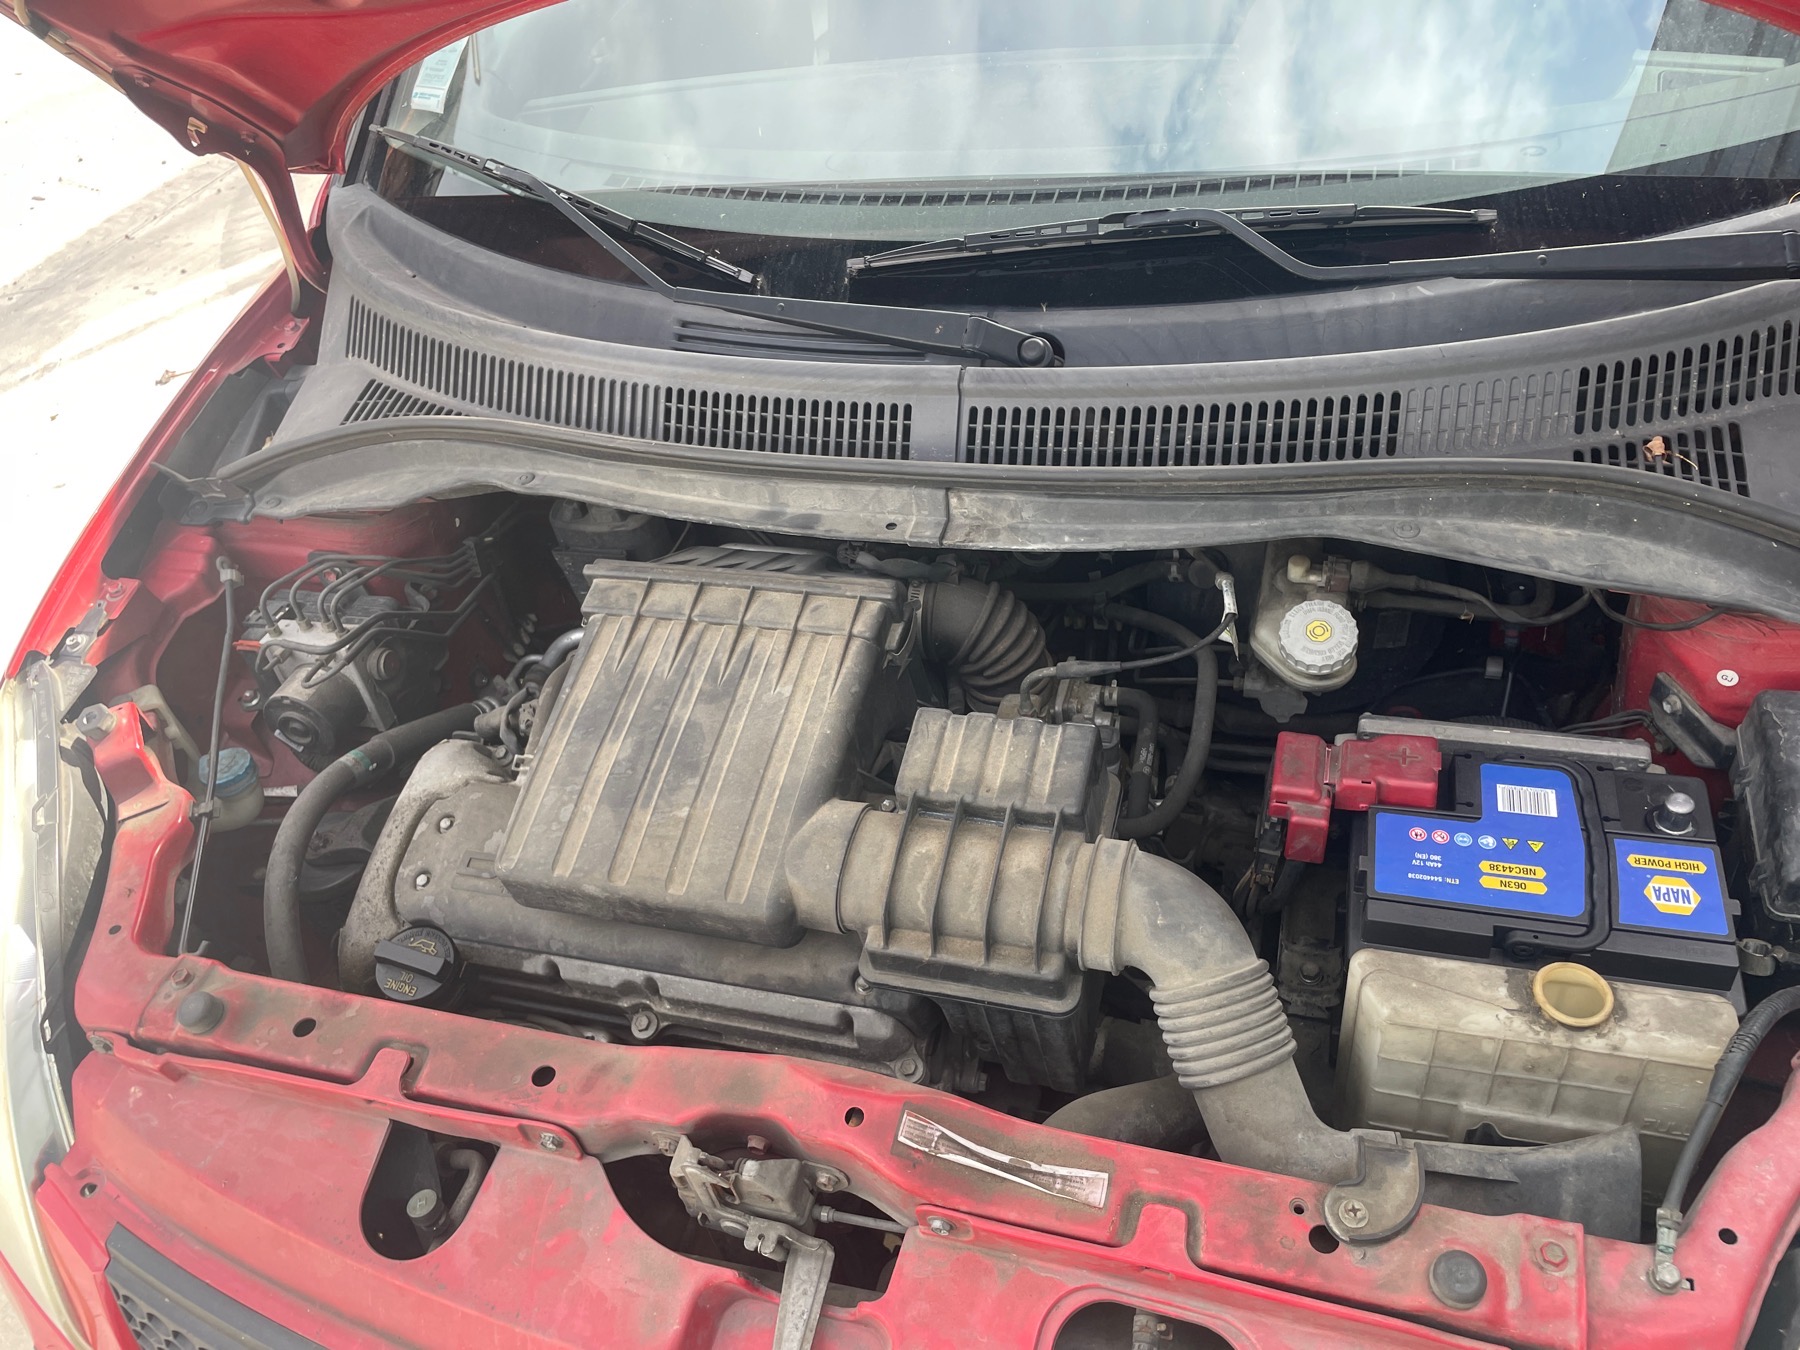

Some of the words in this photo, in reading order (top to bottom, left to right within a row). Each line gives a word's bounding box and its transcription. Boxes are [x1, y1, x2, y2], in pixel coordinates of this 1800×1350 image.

[1721, 674, 1734, 682] GJ
[1634, 857, 1671, 868] POWER
[1674, 861, 1699, 871] HIGH
[1489, 864, 1536, 876] NBC4438
[1444, 877, 1460, 885] ETN:
[1500, 880, 1527, 890] 063N
[1652, 885, 1692, 905] NAPA
[401, 971, 414, 982] OIL
[384, 978, 417, 996] ENGINE
